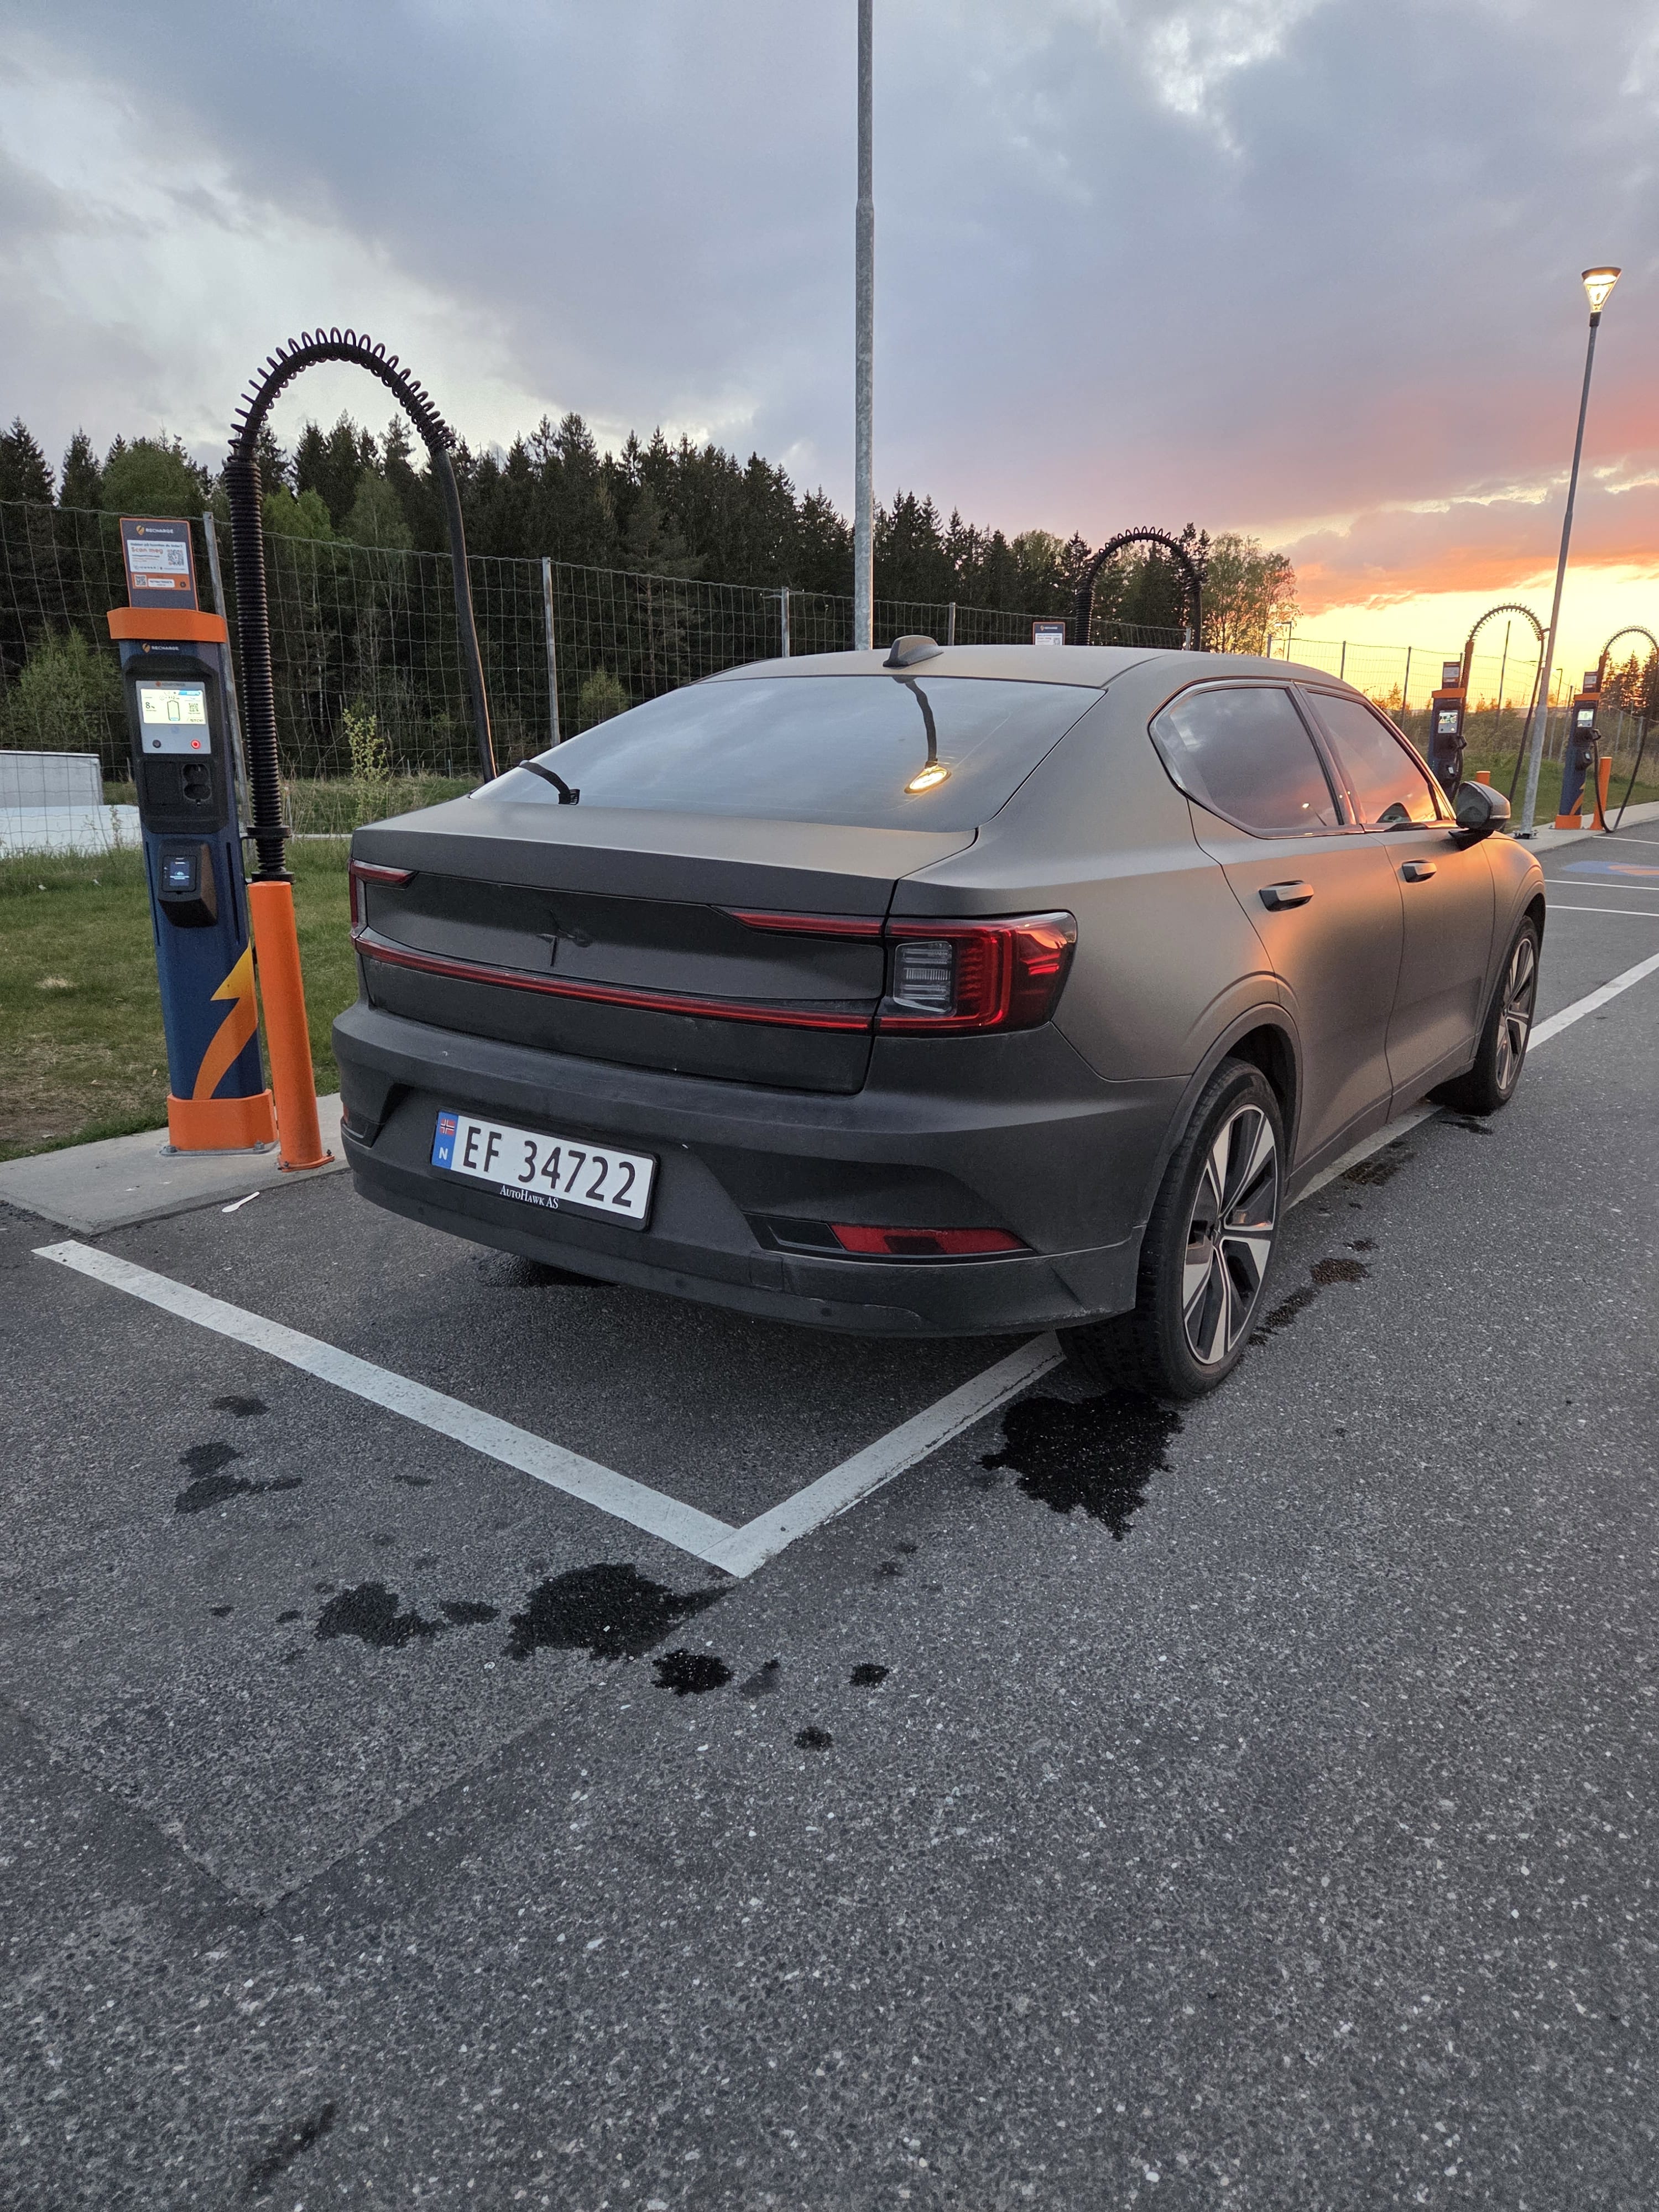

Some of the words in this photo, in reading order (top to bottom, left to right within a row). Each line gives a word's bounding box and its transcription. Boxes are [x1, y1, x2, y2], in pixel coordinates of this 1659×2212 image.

[439, 1147, 448, 1160] N
[463, 1126, 502, 1172] EF
[518, 1140, 636, 1208] 34722
[546, 1196, 559, 1209] AS
